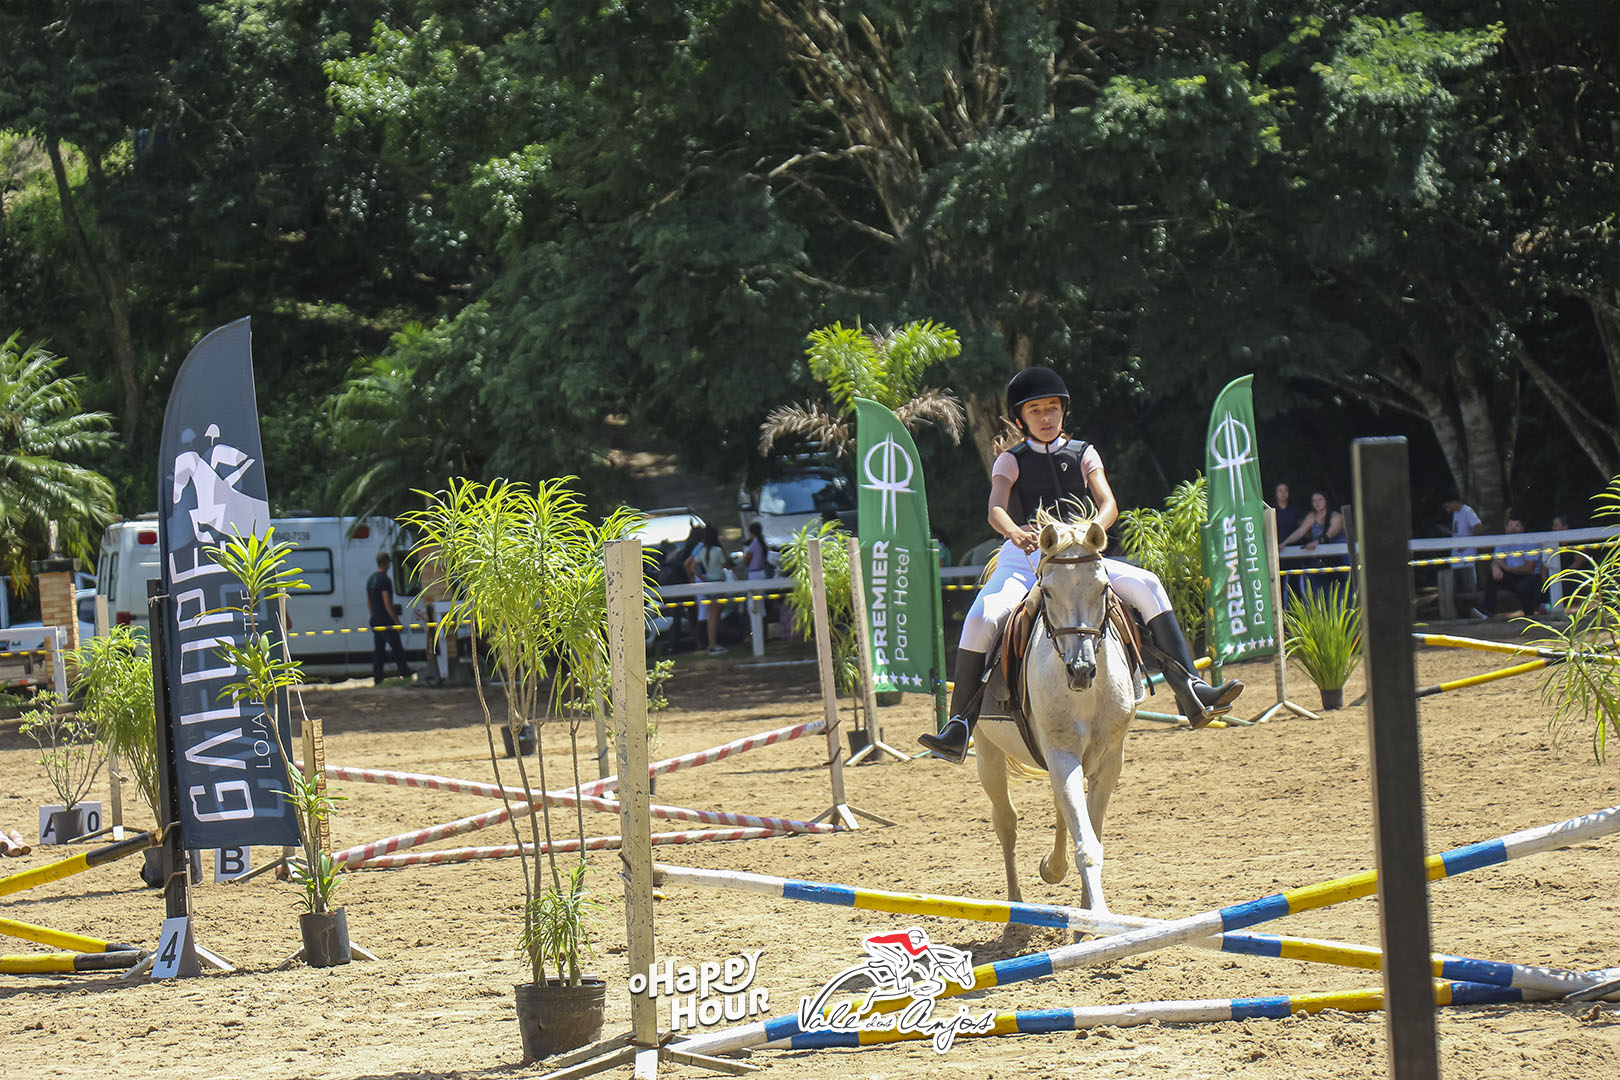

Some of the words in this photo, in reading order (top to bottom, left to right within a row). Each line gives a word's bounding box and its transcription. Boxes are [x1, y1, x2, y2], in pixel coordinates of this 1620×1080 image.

[1241, 516, 1259, 572] Hotel
[872, 540, 890, 665] PREMIER
[893, 547, 910, 605] Hotel
[1223, 514, 1248, 635] PREMIER
[1253, 578, 1266, 625] Parc
[895, 613, 909, 661] Parc
[251, 712, 271, 768] LOJA
[220, 847, 245, 875] B
[160, 931, 179, 969] 4
